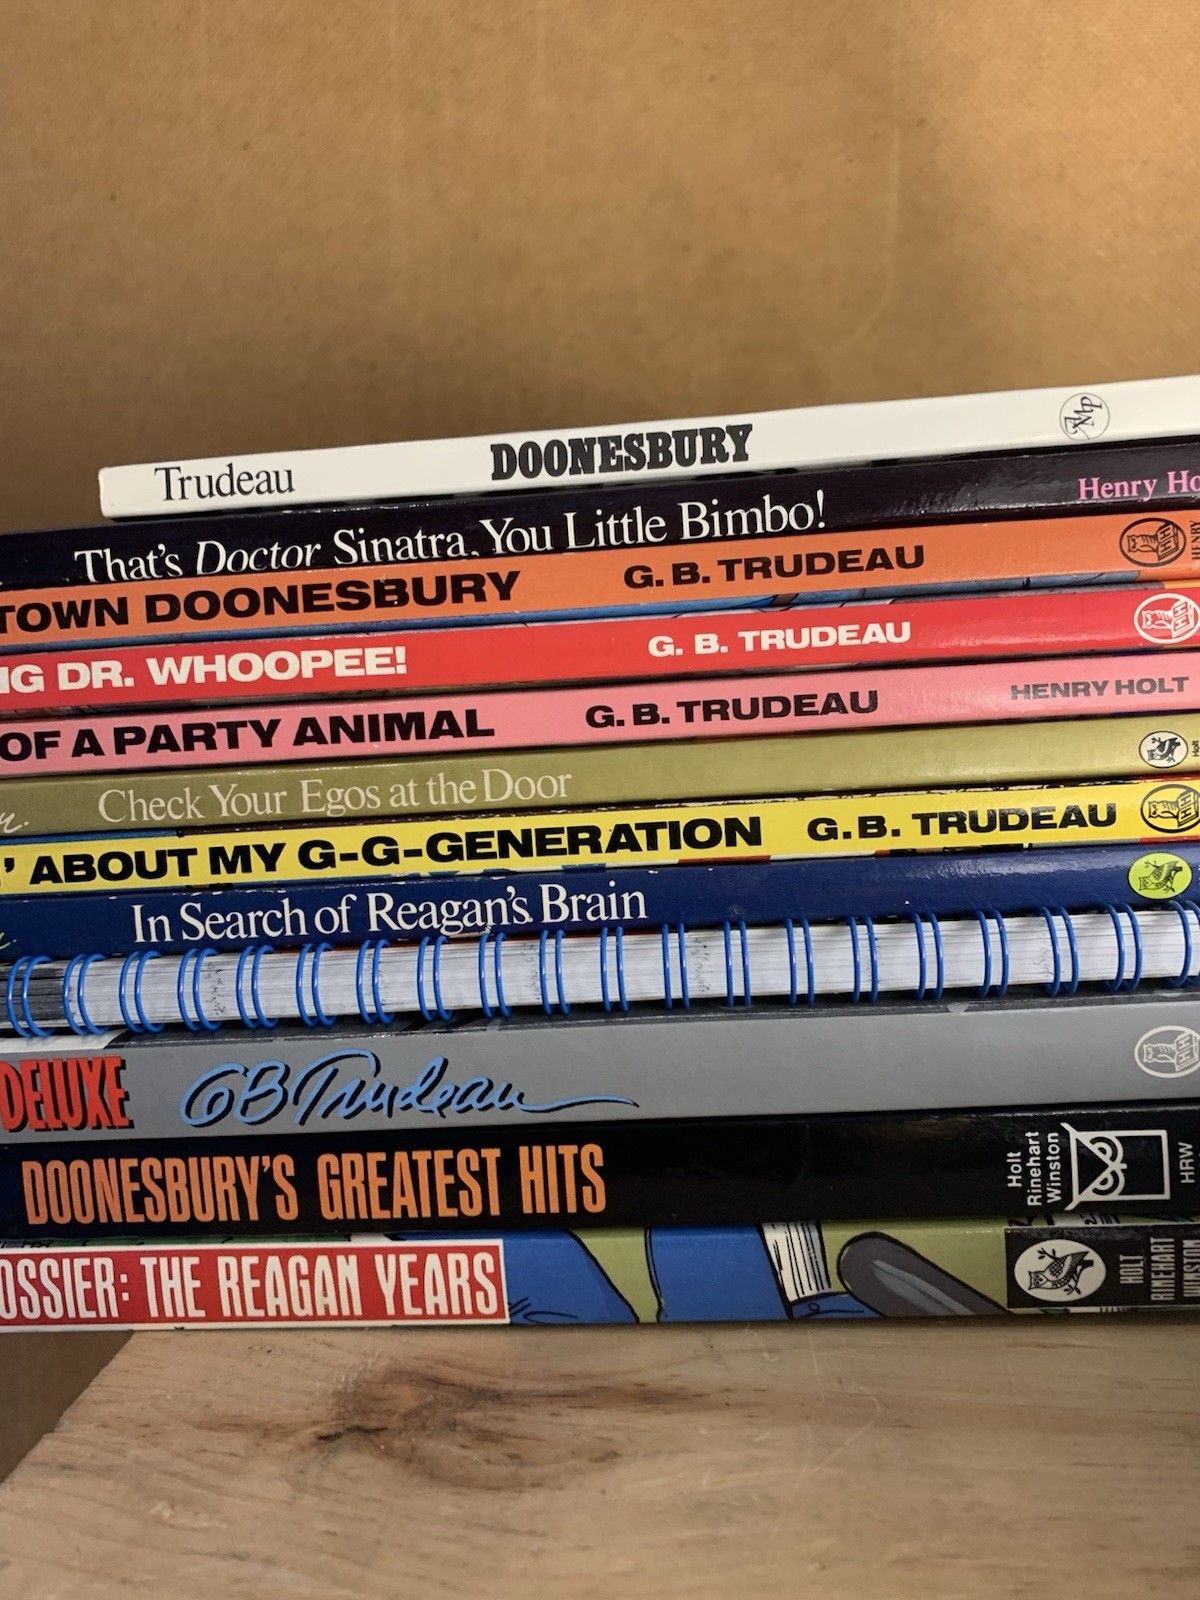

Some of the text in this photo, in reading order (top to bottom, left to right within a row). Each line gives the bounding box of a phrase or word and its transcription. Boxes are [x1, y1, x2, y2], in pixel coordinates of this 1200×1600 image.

[490, 423, 753, 481] DOONESBURY
[154, 463, 296, 502] Trudeau
[1078, 473, 1159, 502] Henry
[73, 544, 184, 583] That's
[196, 539, 322, 576] Doctor
[479, 516, 555, 556] You
[563, 504, 668, 550] Little
[677, 488, 827, 541] Bimbo!
[717, 545, 925, 580] TRUDEAU
[145, 570, 521, 624] DOONESBURY
[737, 620, 912, 650] TRUDEAU
[57, 659, 135, 692] DR.
[147, 645, 408, 686] WHOOPEE!
[1011, 676, 1190, 701] HENRY HOLT
[676, 689, 879, 721] TRUDEAU
[0, 707, 496, 762] OF A PARTY ANIMAL
[98, 767, 574, 824] Check Your Egos at the Door
[912, 803, 1118, 835] TRUDEAU
[29, 847, 199, 885] ABOUT
[209, 841, 286, 875] MY
[298, 815, 763, 870] G-G-GENERATION
[133, 880, 649, 943] In Search of Reagan's Brain
[0, 1055, 135, 1132] DELUXE
[21, 1143, 607, 1225] DOONESBURY'S GREATEST HITS
[1006, 1151, 1023, 1188] Holt
[1024, 1131, 1043, 1207] Rinehart
[1045, 1132, 1061, 1204] Winston
[1178, 1142, 1196, 1185] HRW
[140, 1254, 206, 1318] THE
[216, 1252, 366, 1317] REAGAN
[375, 1251, 497, 1315] YEARS
[1119, 1254, 1145, 1285] HOLT
[1150, 1236, 1176, 1301] RINEHART
